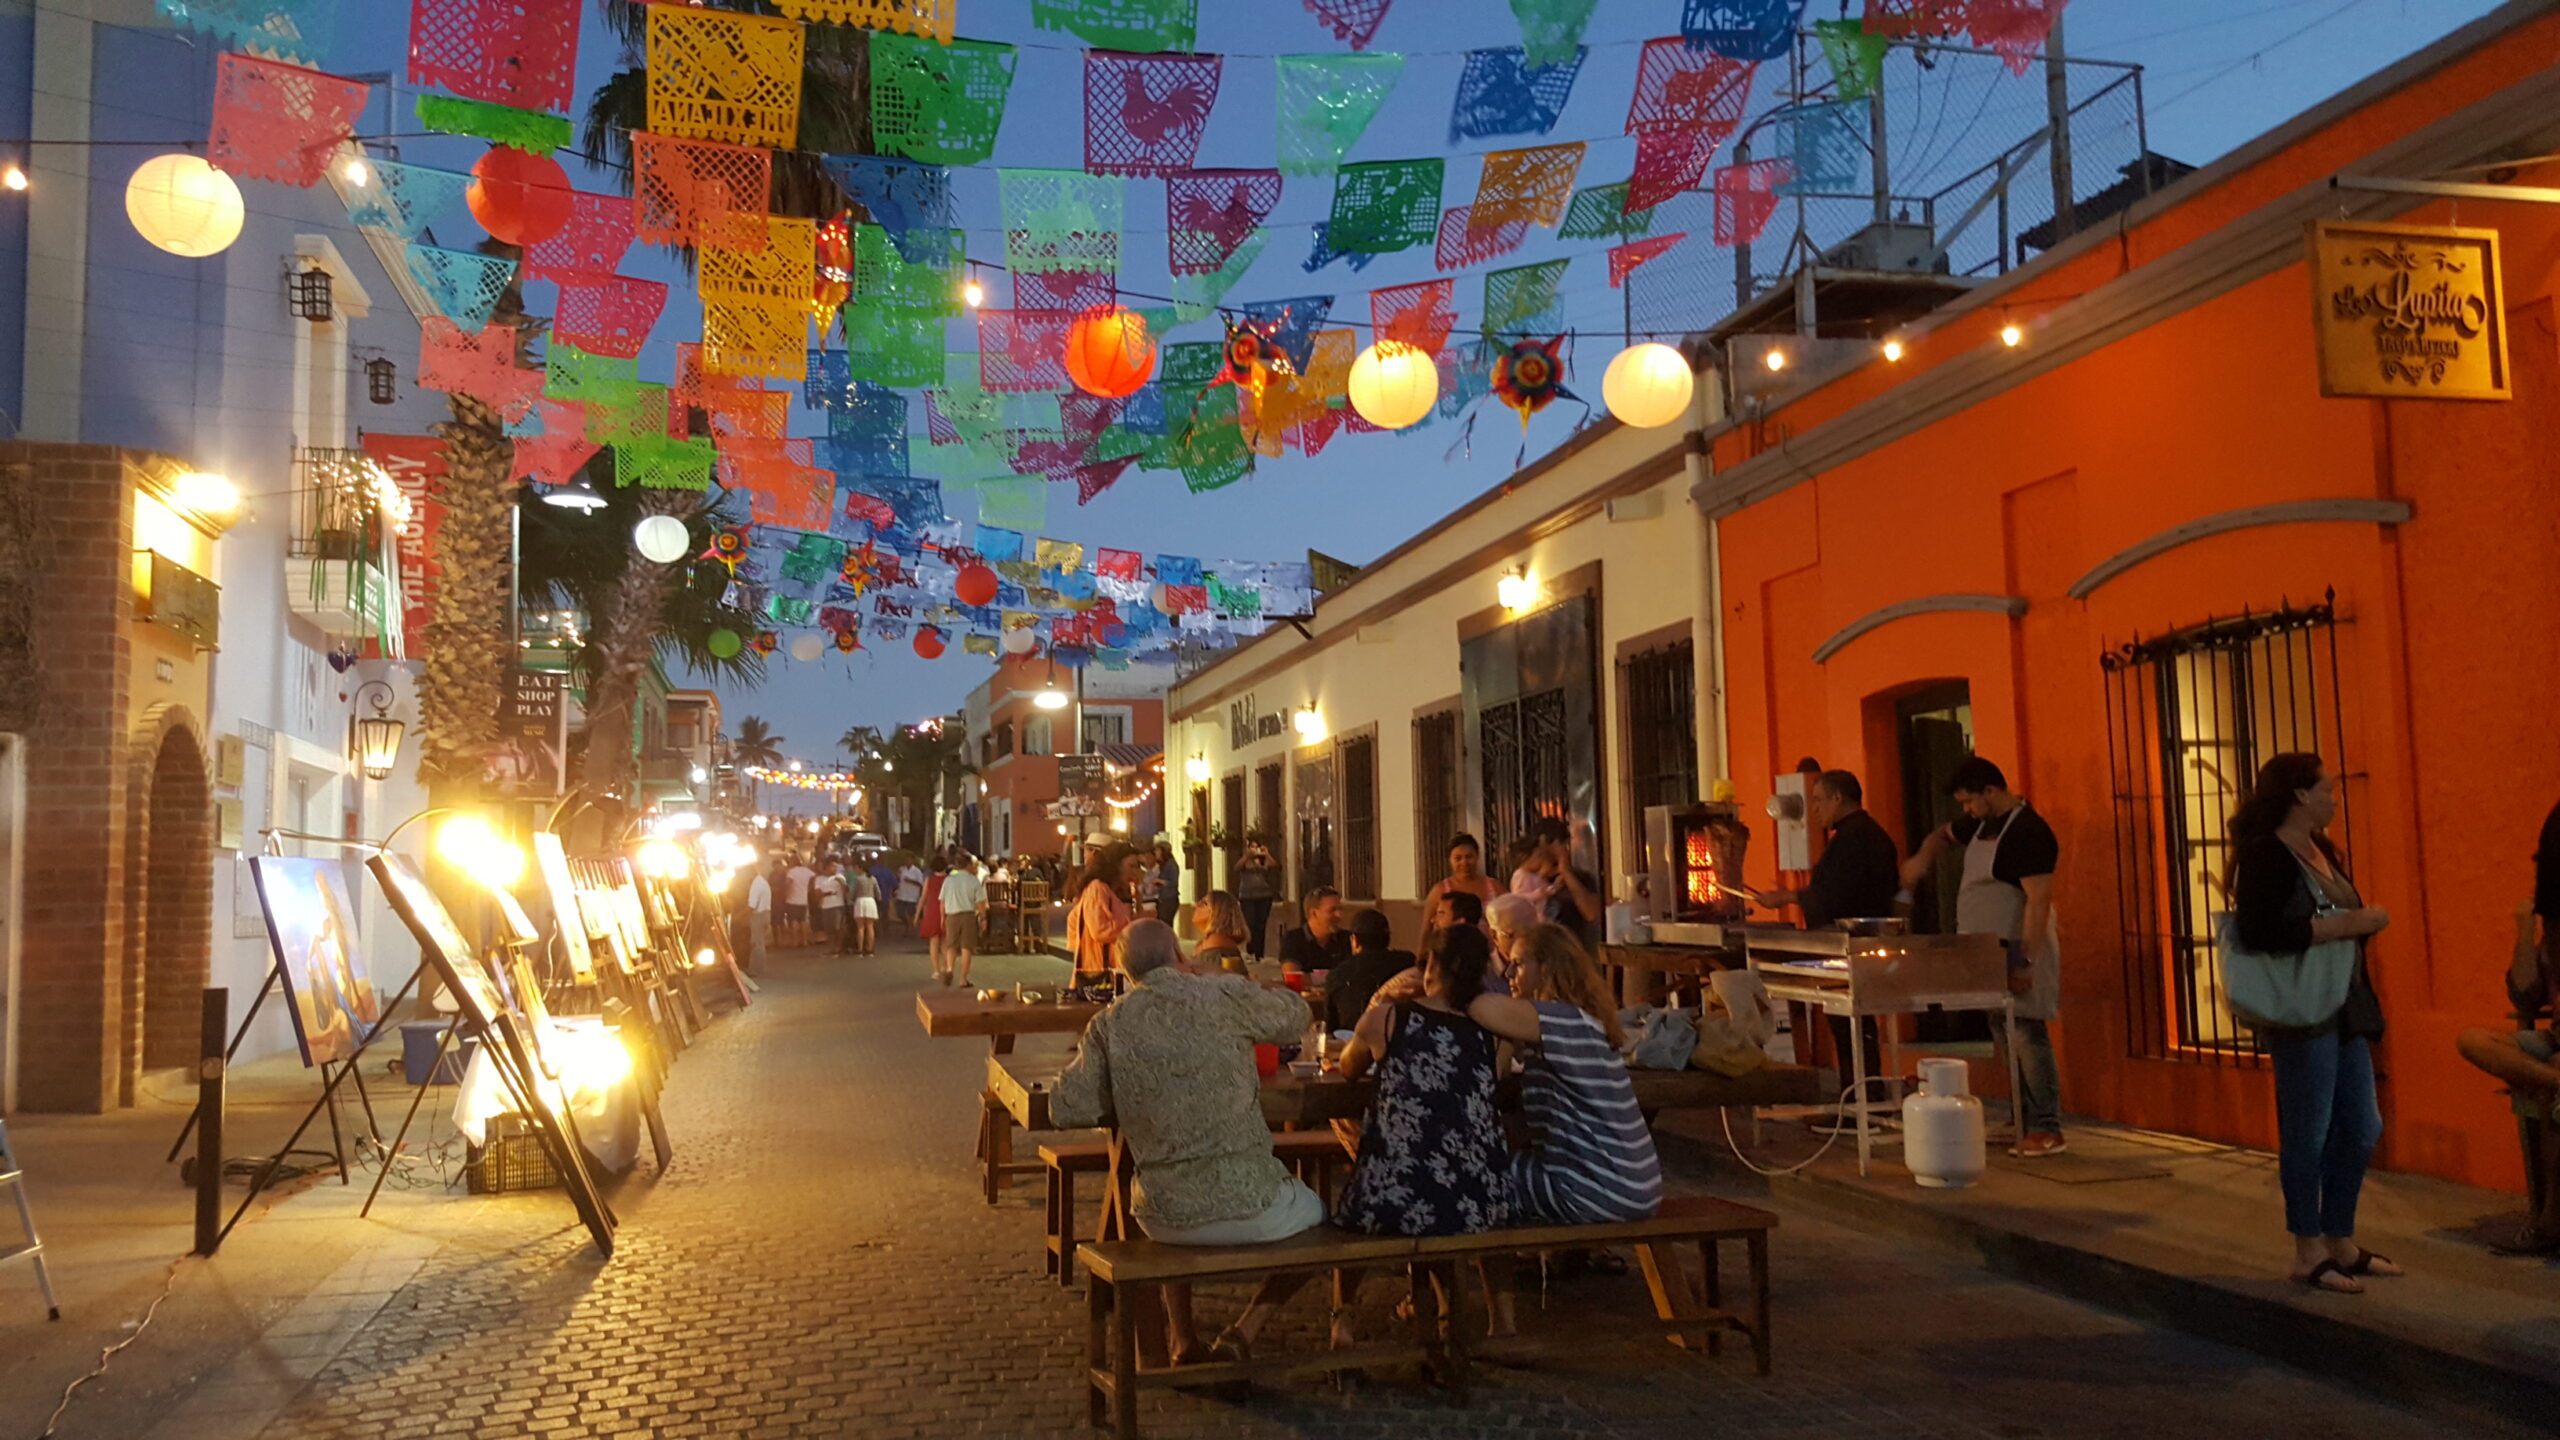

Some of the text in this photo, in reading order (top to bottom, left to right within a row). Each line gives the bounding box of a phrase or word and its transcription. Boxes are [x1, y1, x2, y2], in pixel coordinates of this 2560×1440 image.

[402, 563, 425, 611] THE
[519, 675, 555, 688] EAT
[517, 690, 556, 702] SHOP
[517, 704, 554, 717] PLAY
